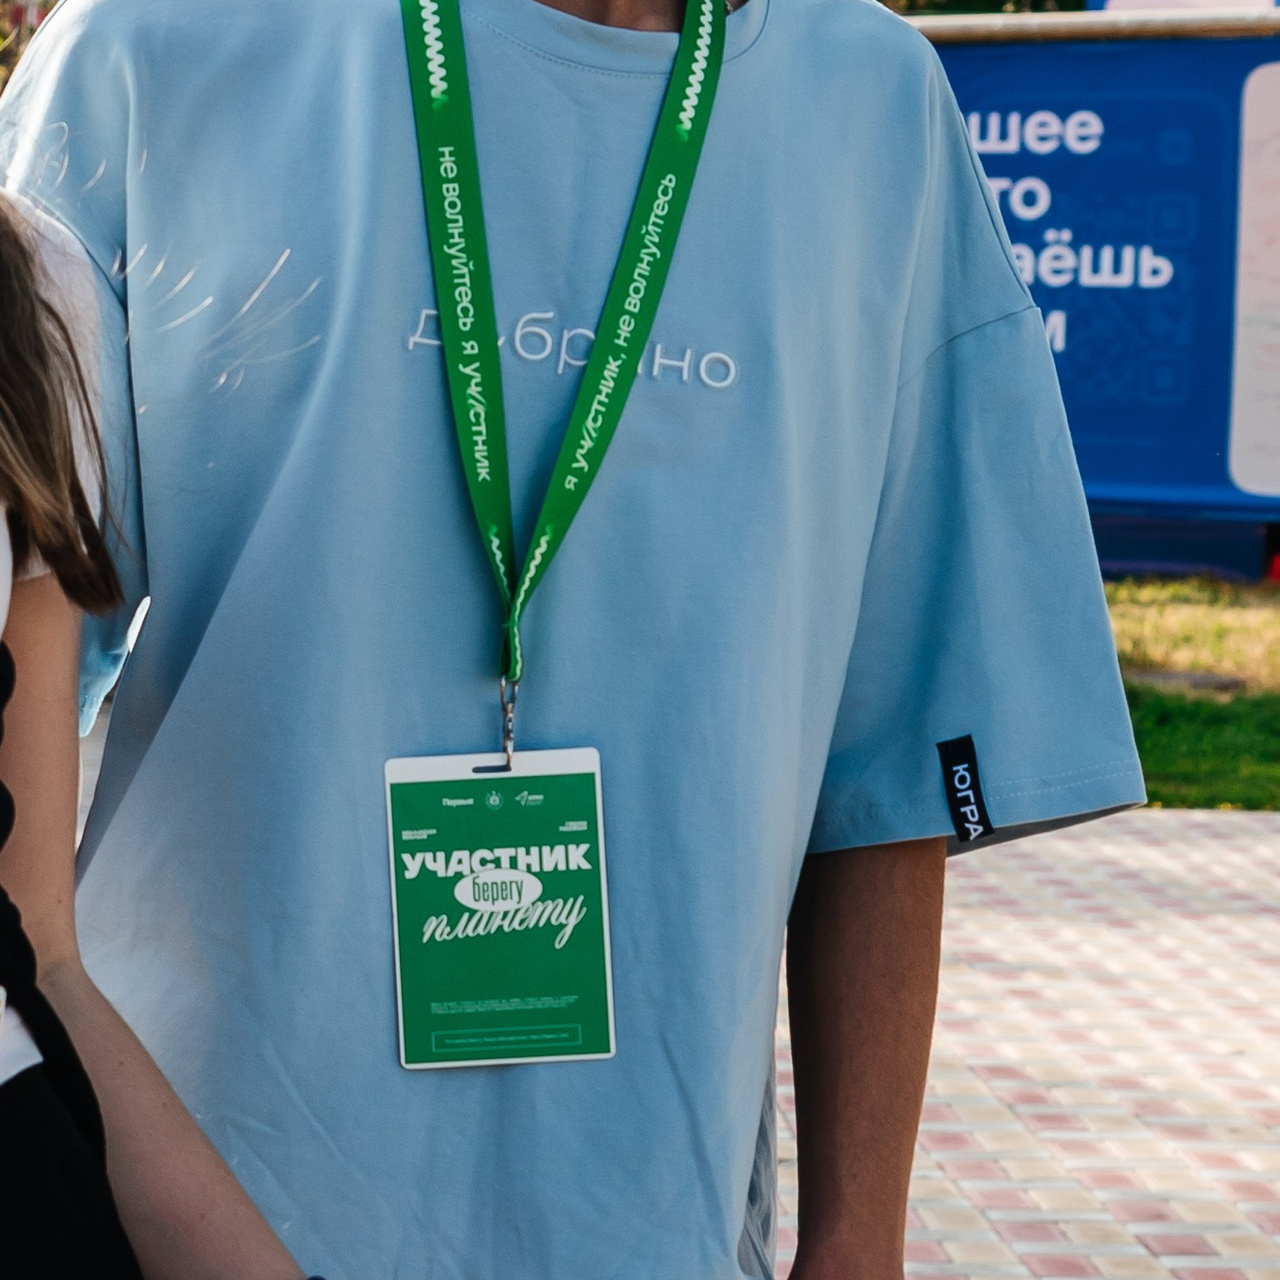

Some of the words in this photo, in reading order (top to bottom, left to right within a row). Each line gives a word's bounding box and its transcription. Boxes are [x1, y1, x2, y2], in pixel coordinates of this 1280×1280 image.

[438, 146, 458, 179] не
[442, 182, 476, 332] волнуйтесь
[624, 172, 677, 314] волнуйтесь
[460, 340, 480, 356] я
[614, 314, 636, 348] не
[564, 474, 579, 491] я
[952, 763, 984, 840] ЮГРА
[401, 844, 593, 880] УЧАСТНИК
[471, 872, 525, 907] берегу
[422, 894, 587, 950] планету
